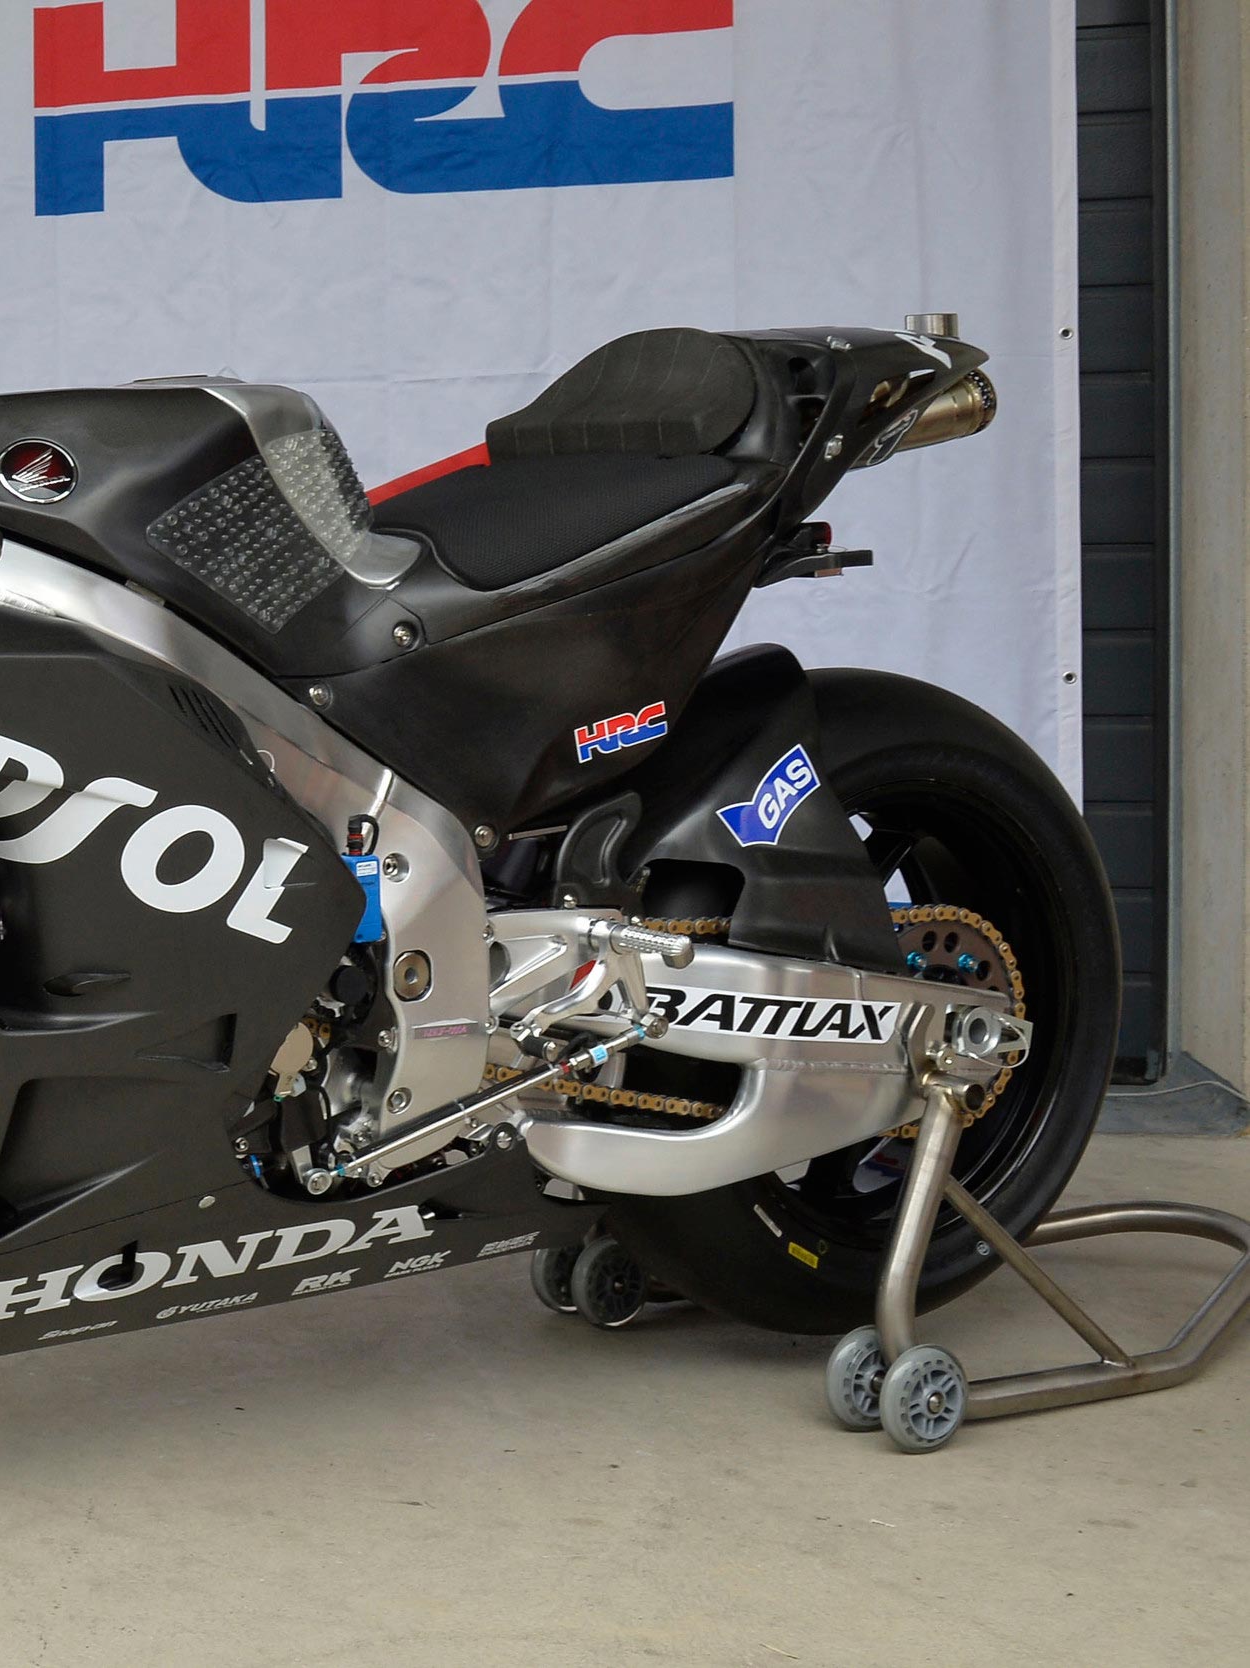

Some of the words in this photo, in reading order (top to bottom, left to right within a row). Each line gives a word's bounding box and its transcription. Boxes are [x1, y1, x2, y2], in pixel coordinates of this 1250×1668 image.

[34, 0, 734, 217] HRC
[574, 700, 668, 763] HRC
[757, 758, 813, 830] GAS
[645, 986, 896, 1041] BATTLAX
[293, 1267, 361, 1293] RK
[388, 1250, 451, 1275] NGK
